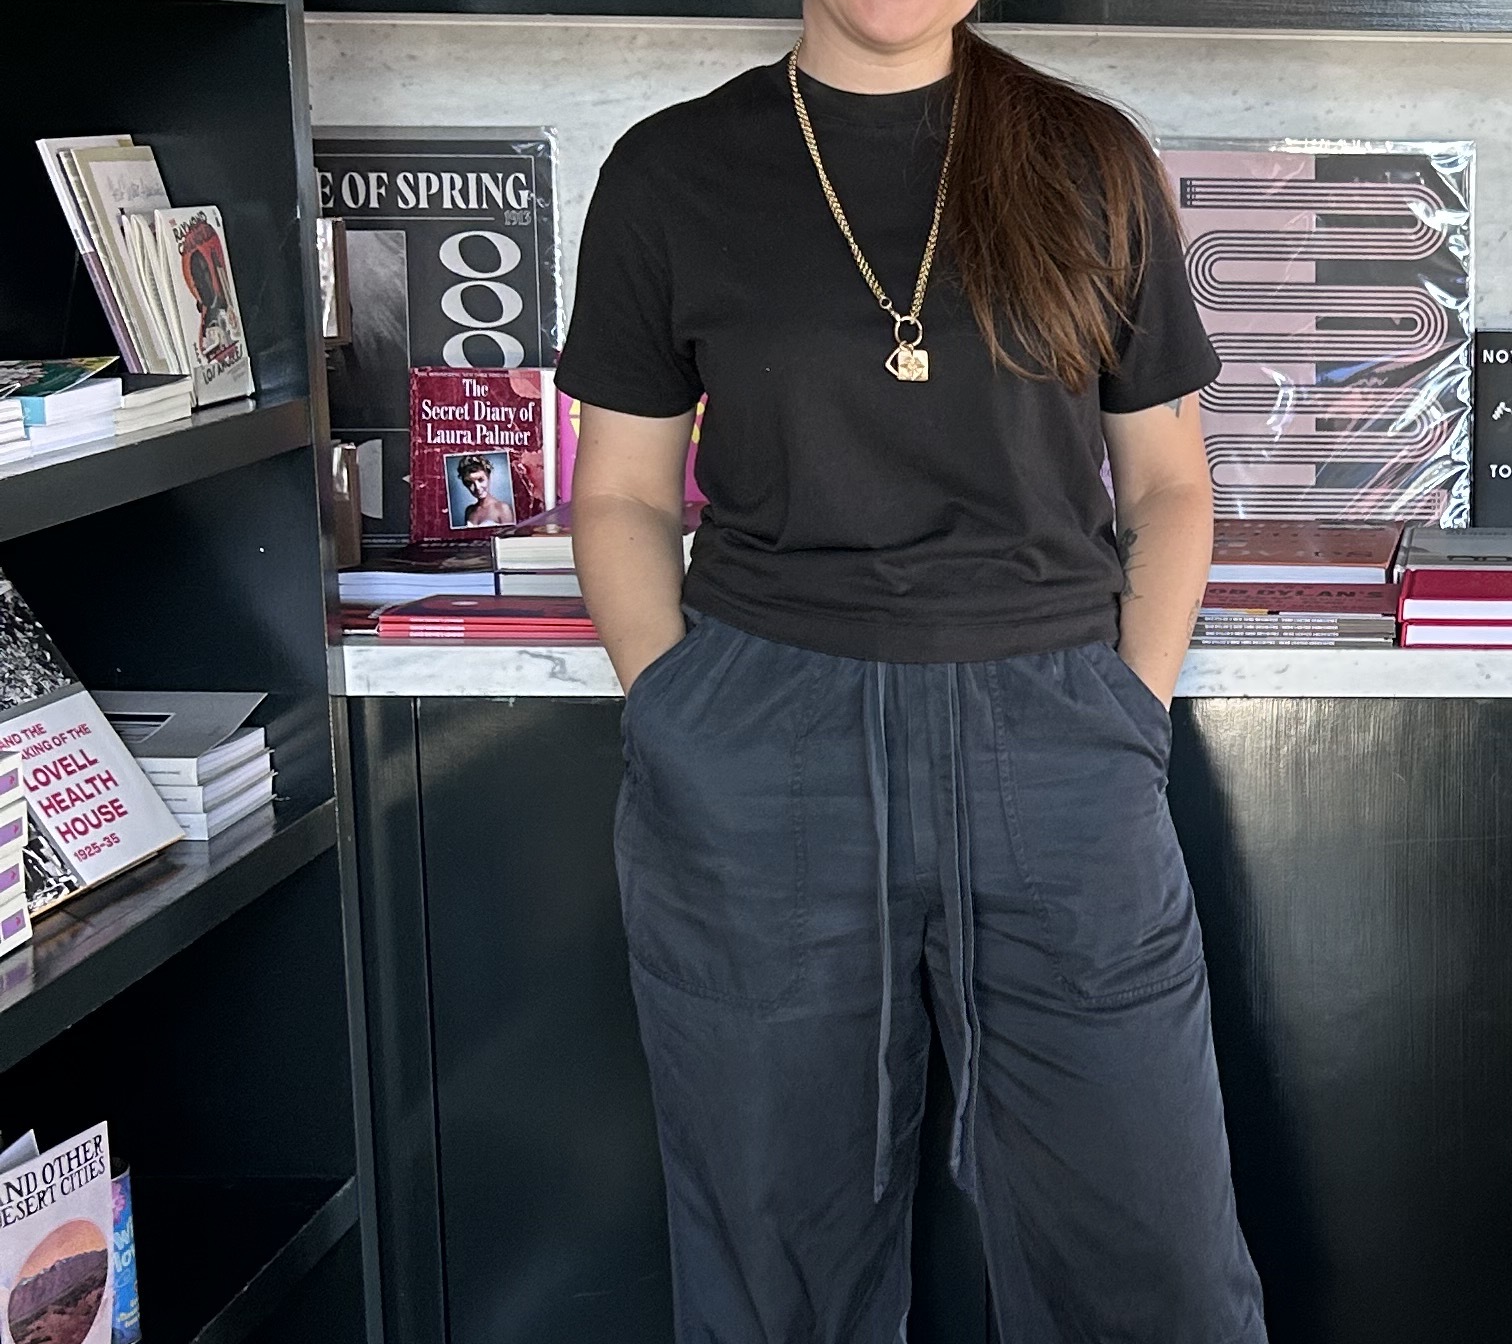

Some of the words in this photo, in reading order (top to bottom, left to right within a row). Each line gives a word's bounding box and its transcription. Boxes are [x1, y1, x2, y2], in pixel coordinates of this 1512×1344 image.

[342, 173, 389, 208] OF
[397, 172, 530, 210] SPRING
[503, 210, 532, 227] 1913
[462, 379, 488, 398] The
[422, 400, 470, 421] Secret
[473, 402, 516, 428] Diary
[519, 402, 534, 422] of
[426, 423, 472, 445] Laura
[475, 424, 531, 446] Palmer
[1489, 464, 1512, 479] TO
[23, 749, 99, 793] LOVELL
[38, 770, 119, 818] HEALTH
[55, 798, 129, 845] HOUSE
[73, 832, 121, 863] 1925-35
[42, 1133, 105, 1184] OTHER
[60, 1154, 106, 1198] CITIES
